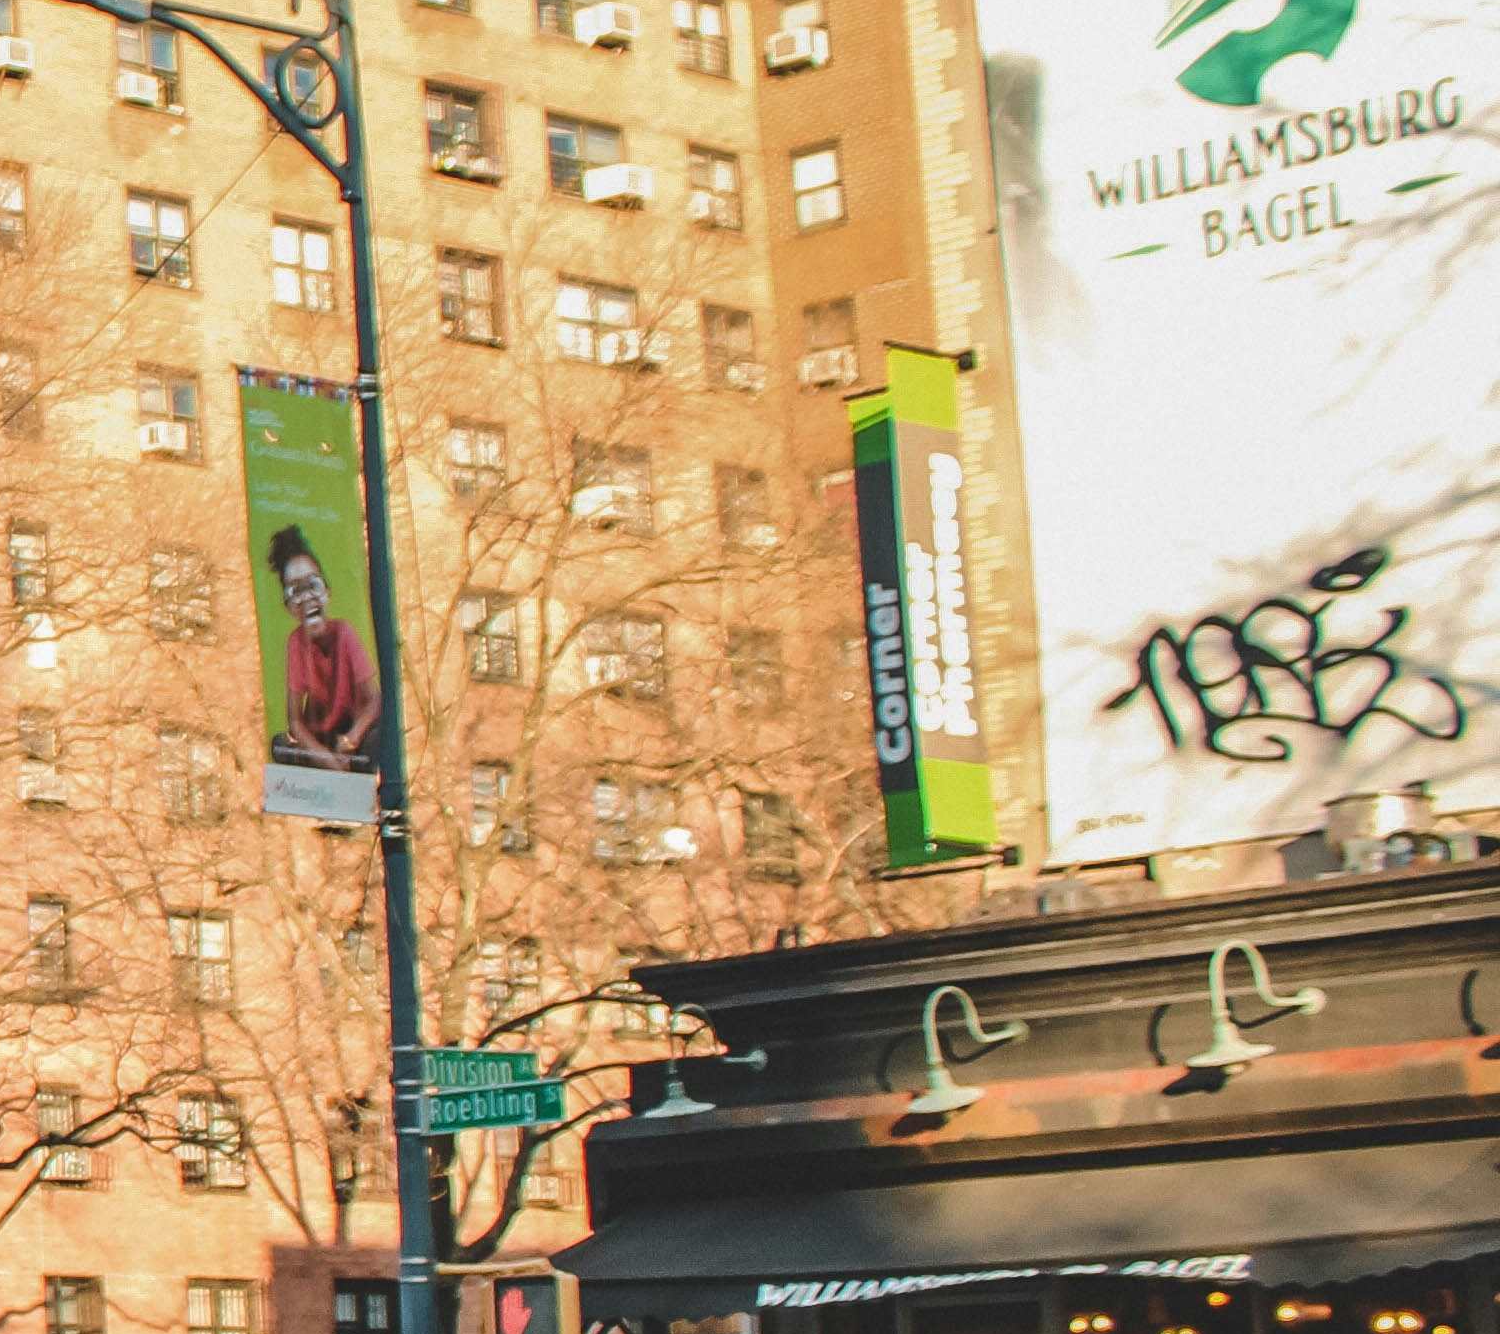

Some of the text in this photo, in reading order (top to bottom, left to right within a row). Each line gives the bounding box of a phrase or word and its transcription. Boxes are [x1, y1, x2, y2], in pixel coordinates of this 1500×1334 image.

[1086, 75, 1463, 210] WILLIAMSBURG
[1202, 181, 1354, 259] BAGEL
[866, 581, 913, 765] Corner
[424, 1052, 513, 1086] Division
[429, 1089, 537, 1127] Roebling
[755, 1268, 1039, 1307] WILLIAM
